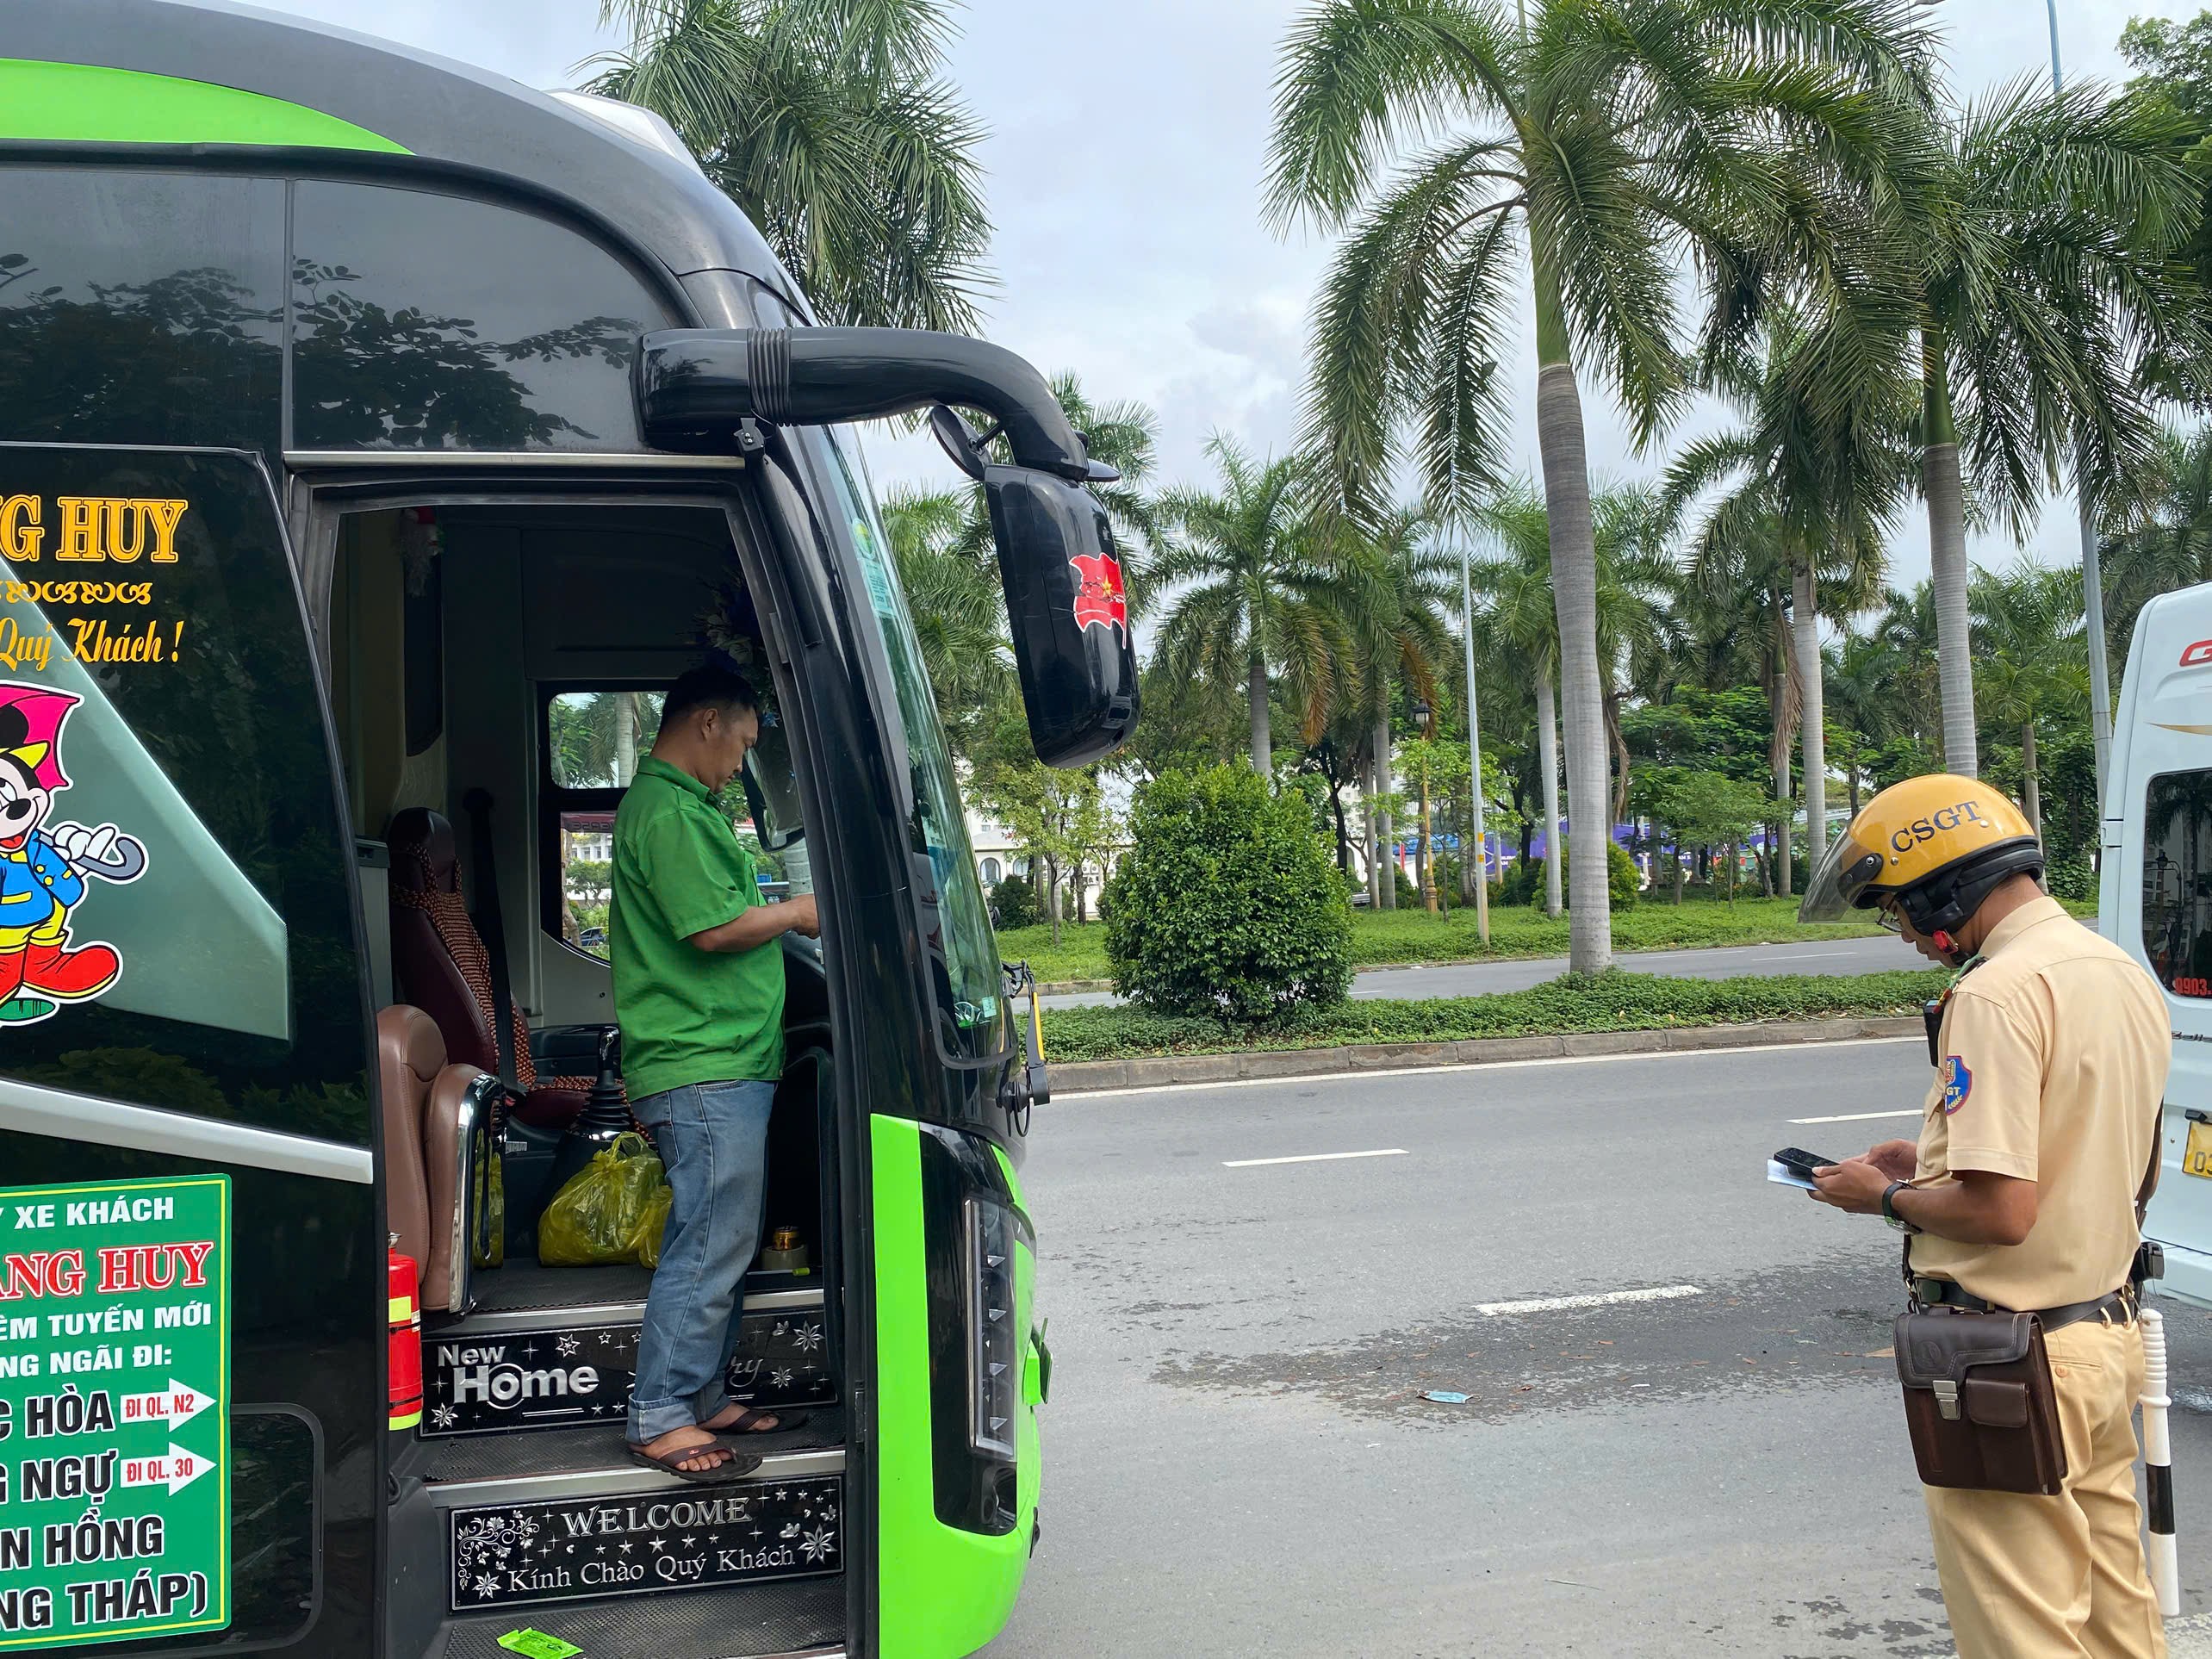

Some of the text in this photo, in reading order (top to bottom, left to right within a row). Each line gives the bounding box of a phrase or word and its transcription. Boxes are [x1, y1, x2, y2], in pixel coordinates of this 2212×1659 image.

[0, 494, 189, 563] G HUY
[62, 618, 164, 662] Khách
[1892, 801, 1981, 853] CSGT
[15, 1195, 174, 1230] XE KHÁCH
[0, 1241, 214, 1301] NG HUY
[47, 1302, 144, 1337] TUYẾN
[154, 1300, 212, 1329] MỚI
[49, 1344, 123, 1375] NGÃI
[132, 1344, 172, 1369] ĐI:
[438, 1345, 506, 1366] New
[125, 1398, 141, 1418] ĐI
[174, 1393, 195, 1414] N2
[453, 1365, 600, 1404] Home
[25, 1384, 115, 1438] HÒA
[21, 1448, 119, 1506] NGỰ
[127, 1463, 142, 1482] ĐI
[175, 1457, 194, 1477] 30
[44, 1507, 165, 1567] HỒNG
[561, 1497, 753, 1538] WELCOME
[507, 1544, 795, 1592] Kính Chào Quý Khách
[65, 1568, 208, 1625] THÁP)
